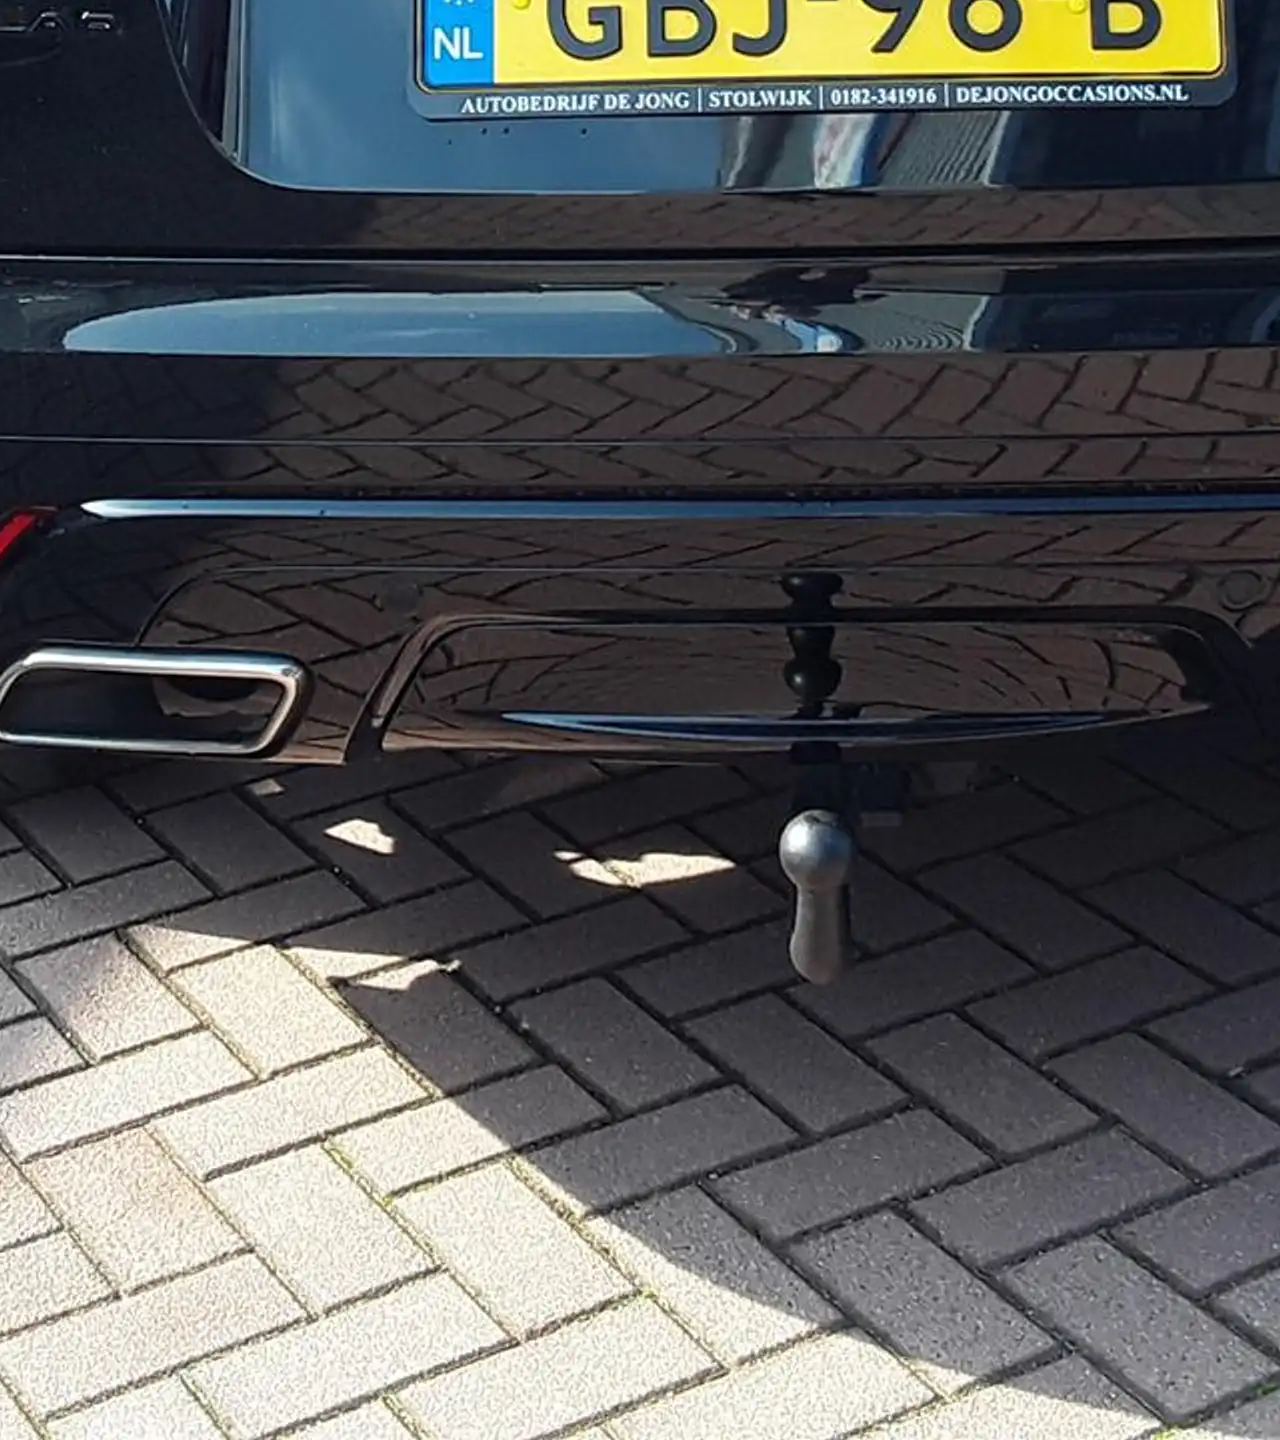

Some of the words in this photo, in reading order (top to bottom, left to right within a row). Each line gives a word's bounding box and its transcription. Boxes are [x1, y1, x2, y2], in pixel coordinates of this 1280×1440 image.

[433, 26, 483, 62] NL
[461, 93, 601, 114] AUTOBEDRIJF
[607, 93, 631, 110] DE
[634, 92, 690, 110] JONG
[708, 90, 812, 108] STOLWIJK
[831, 88, 937, 105] 0182-341916
[956, 85, 1189, 103] DEJONGOCCASIONS.NL
